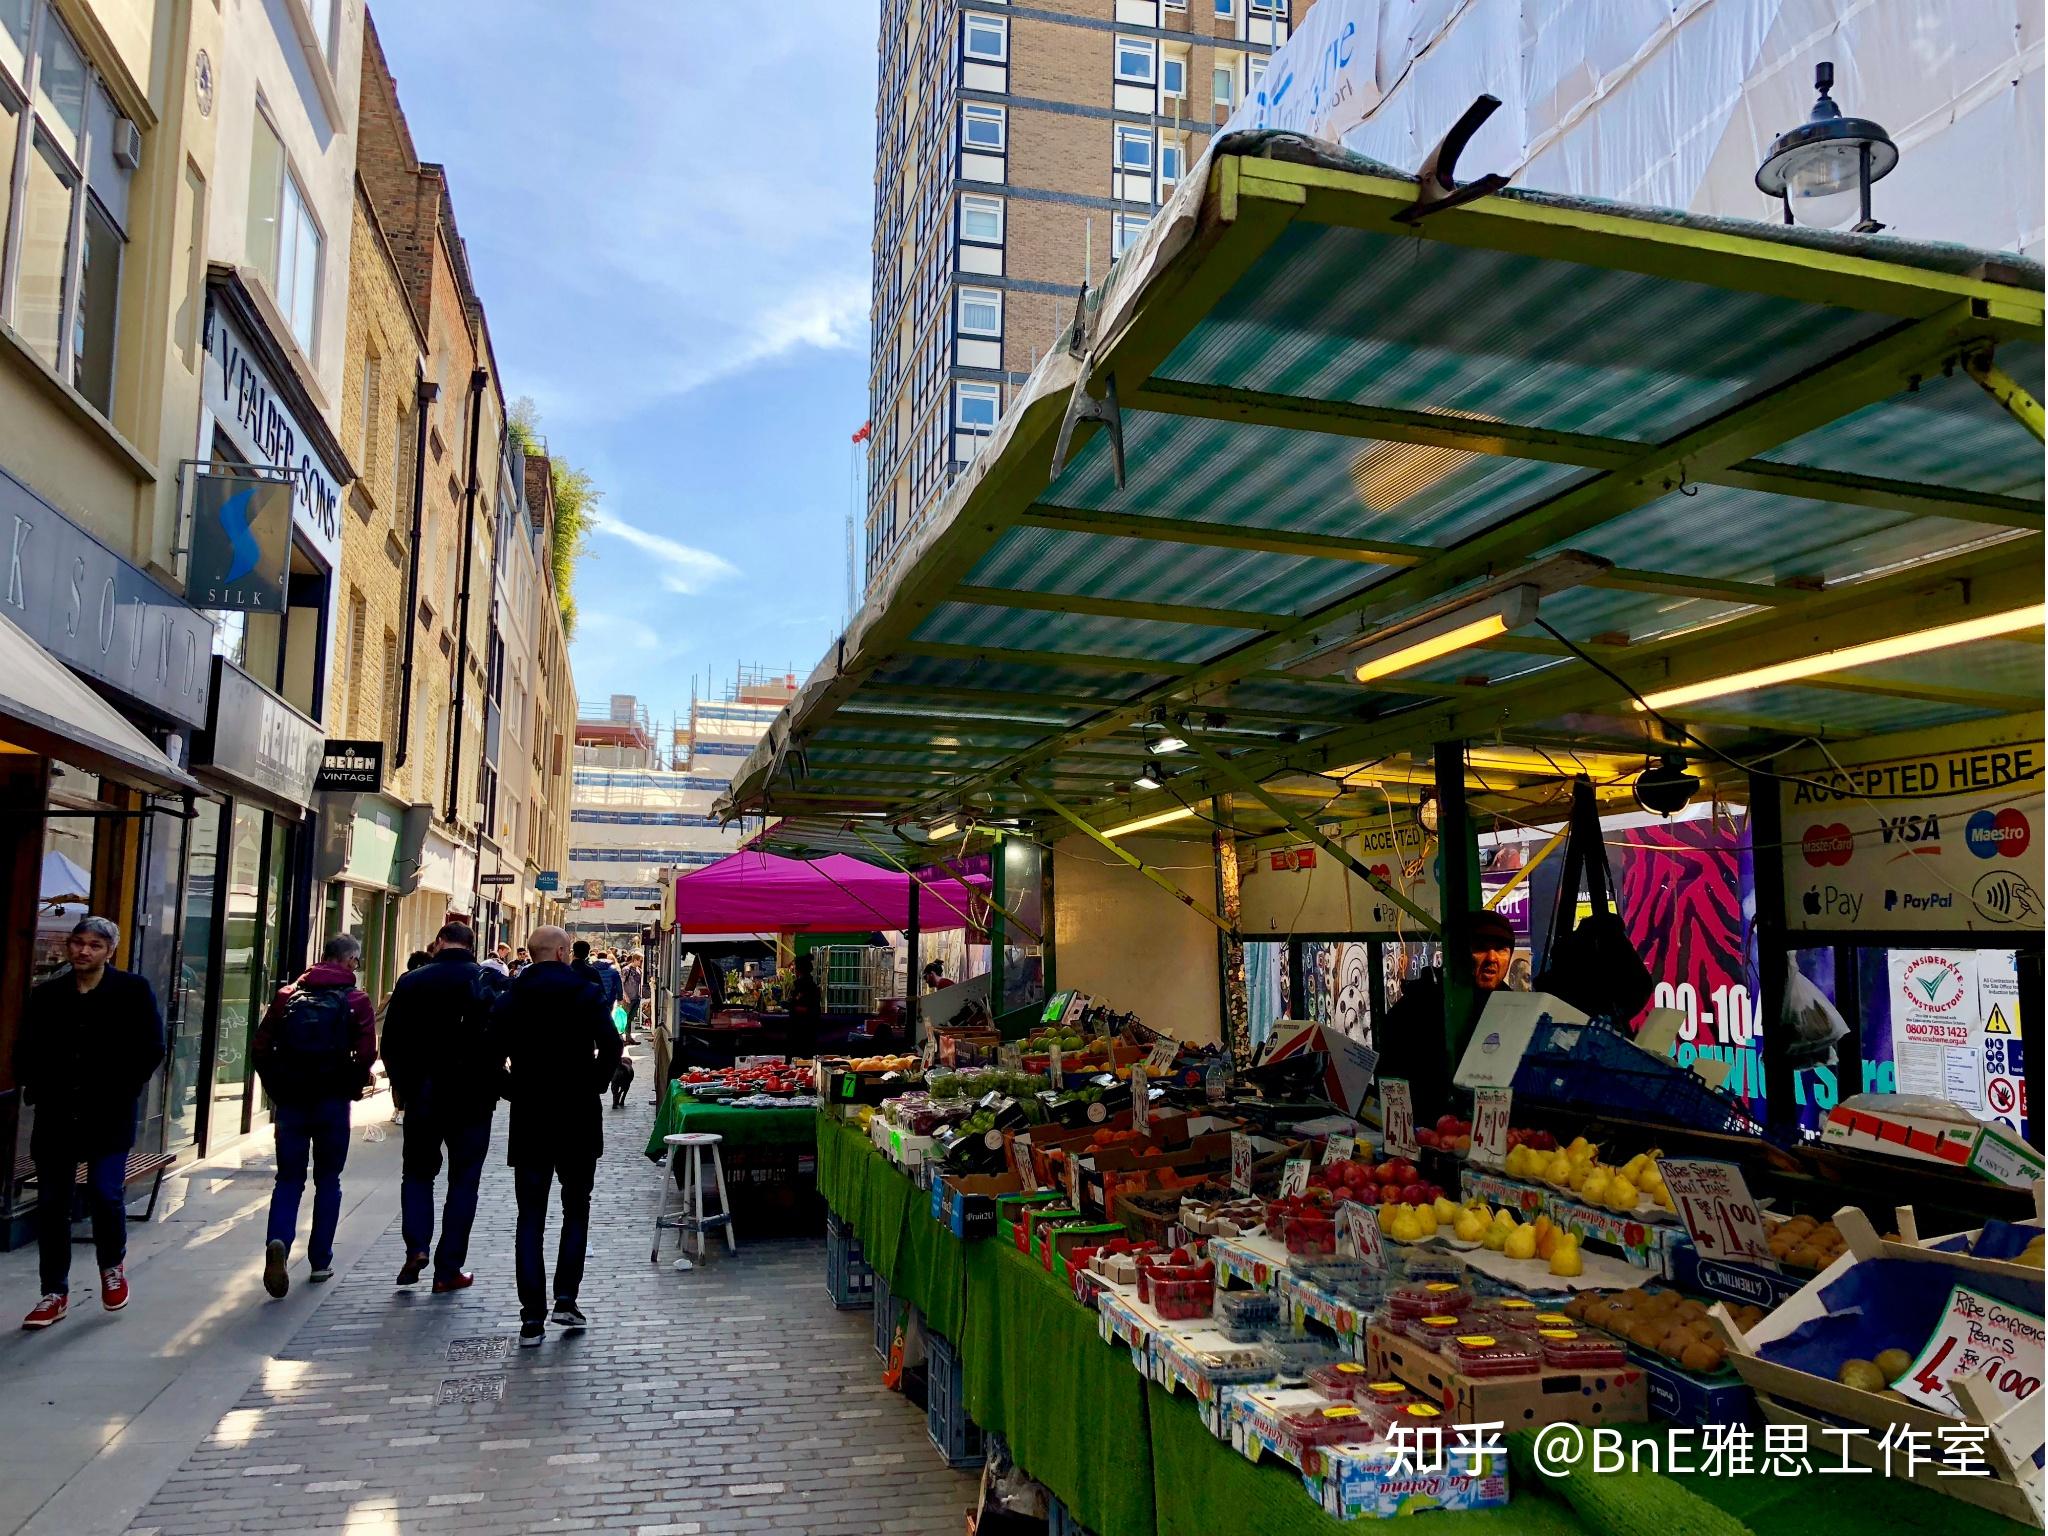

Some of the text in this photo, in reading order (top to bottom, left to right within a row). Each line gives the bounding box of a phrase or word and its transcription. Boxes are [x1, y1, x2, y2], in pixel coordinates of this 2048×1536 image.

[222, 329, 238, 401] V
[237, 358, 295, 481] FALBER
[300, 454, 336, 542] SONS
[208, 588, 263, 605] SILK
[66, 556, 197, 696] SOUND
[324, 755, 376, 770] REIGN
[323, 773, 374, 782] VINTAGE
[1794, 750, 2034, 805] ACCEPTED HERE
[1364, 828, 1420, 851] ACCEPTED
[1879, 814, 1941, 844] VISA
[1971, 827, 2024, 842] Maestro
[1825, 886, 1863, 922] Pay
[1903, 893, 1953, 911] PayPal
[1382, 904, 1398, 926] Pay
[1903, 955, 1964, 983] CONSIDERATE
[1903, 986, 1964, 1013] CONSTRUCTORS
[1905, 1024, 1968, 1038] 0800 783 1423
[1660, 1161, 1727, 1178] Ripe Sweet
[1681, 1197, 1715, 1248] 4
[1955, 1291, 1985, 1318] Ripe
[1967, 1320, 2015, 1355] Pears
[1913, 1336, 1958, 1394] 4
[1379, 1477, 1444, 1499] Roteña
[1447, 1475, 1473, 1492] La
